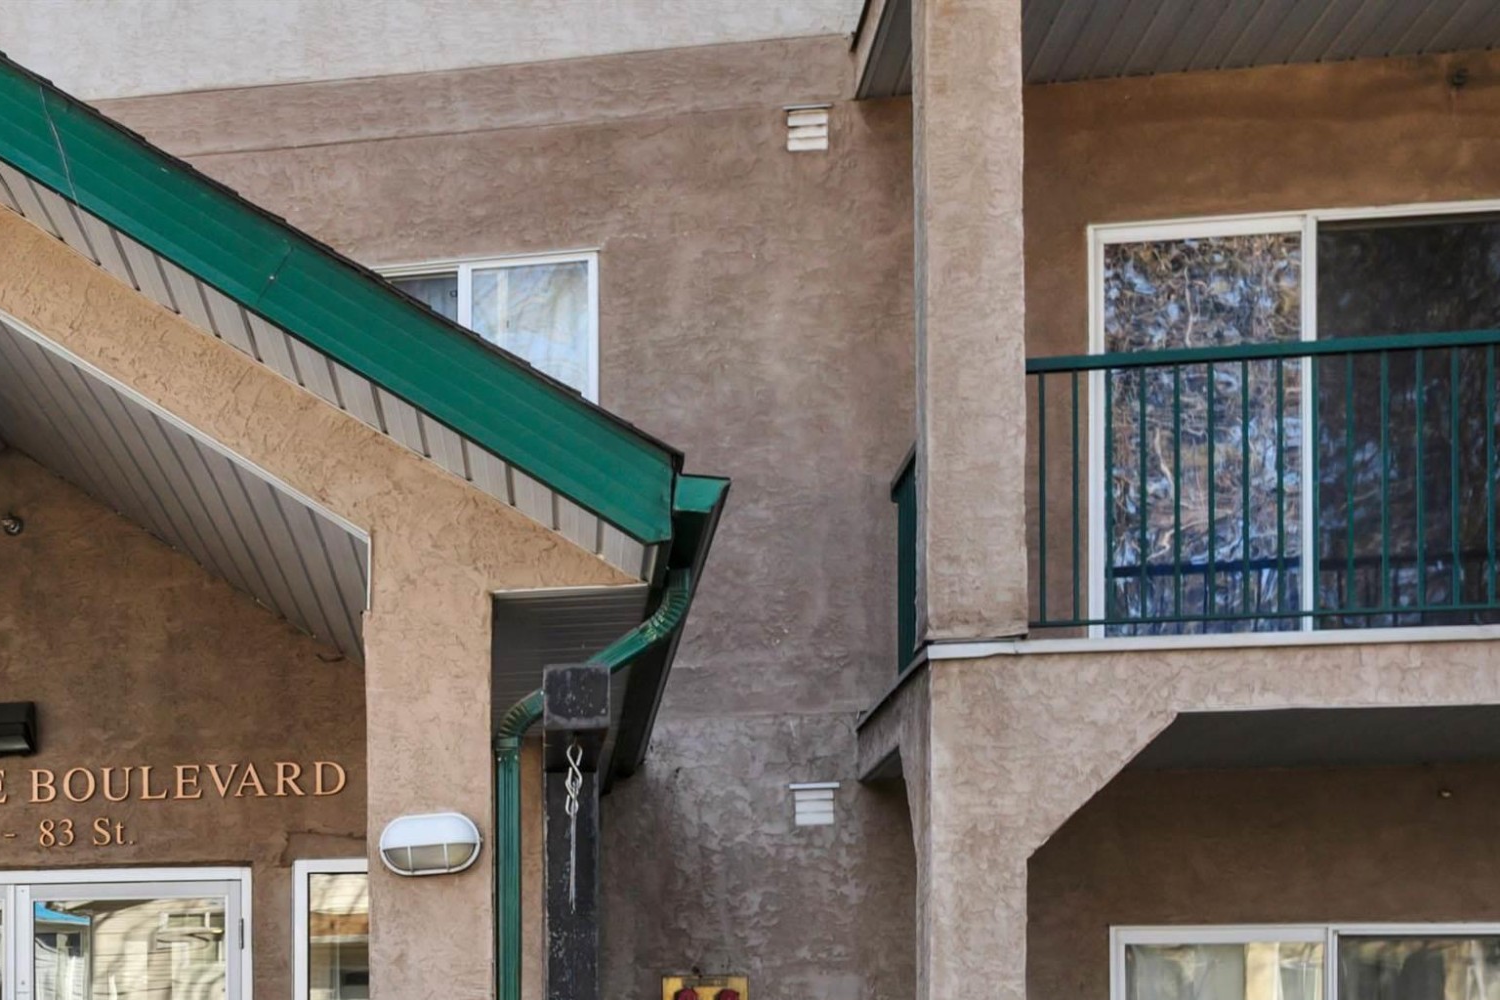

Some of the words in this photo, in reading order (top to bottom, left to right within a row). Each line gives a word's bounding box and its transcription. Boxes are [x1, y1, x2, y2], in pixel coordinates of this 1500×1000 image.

[28, 761, 347, 803] BOULEVARD
[38, 819, 75, 847] 83
[92, 817, 135, 846] St.
